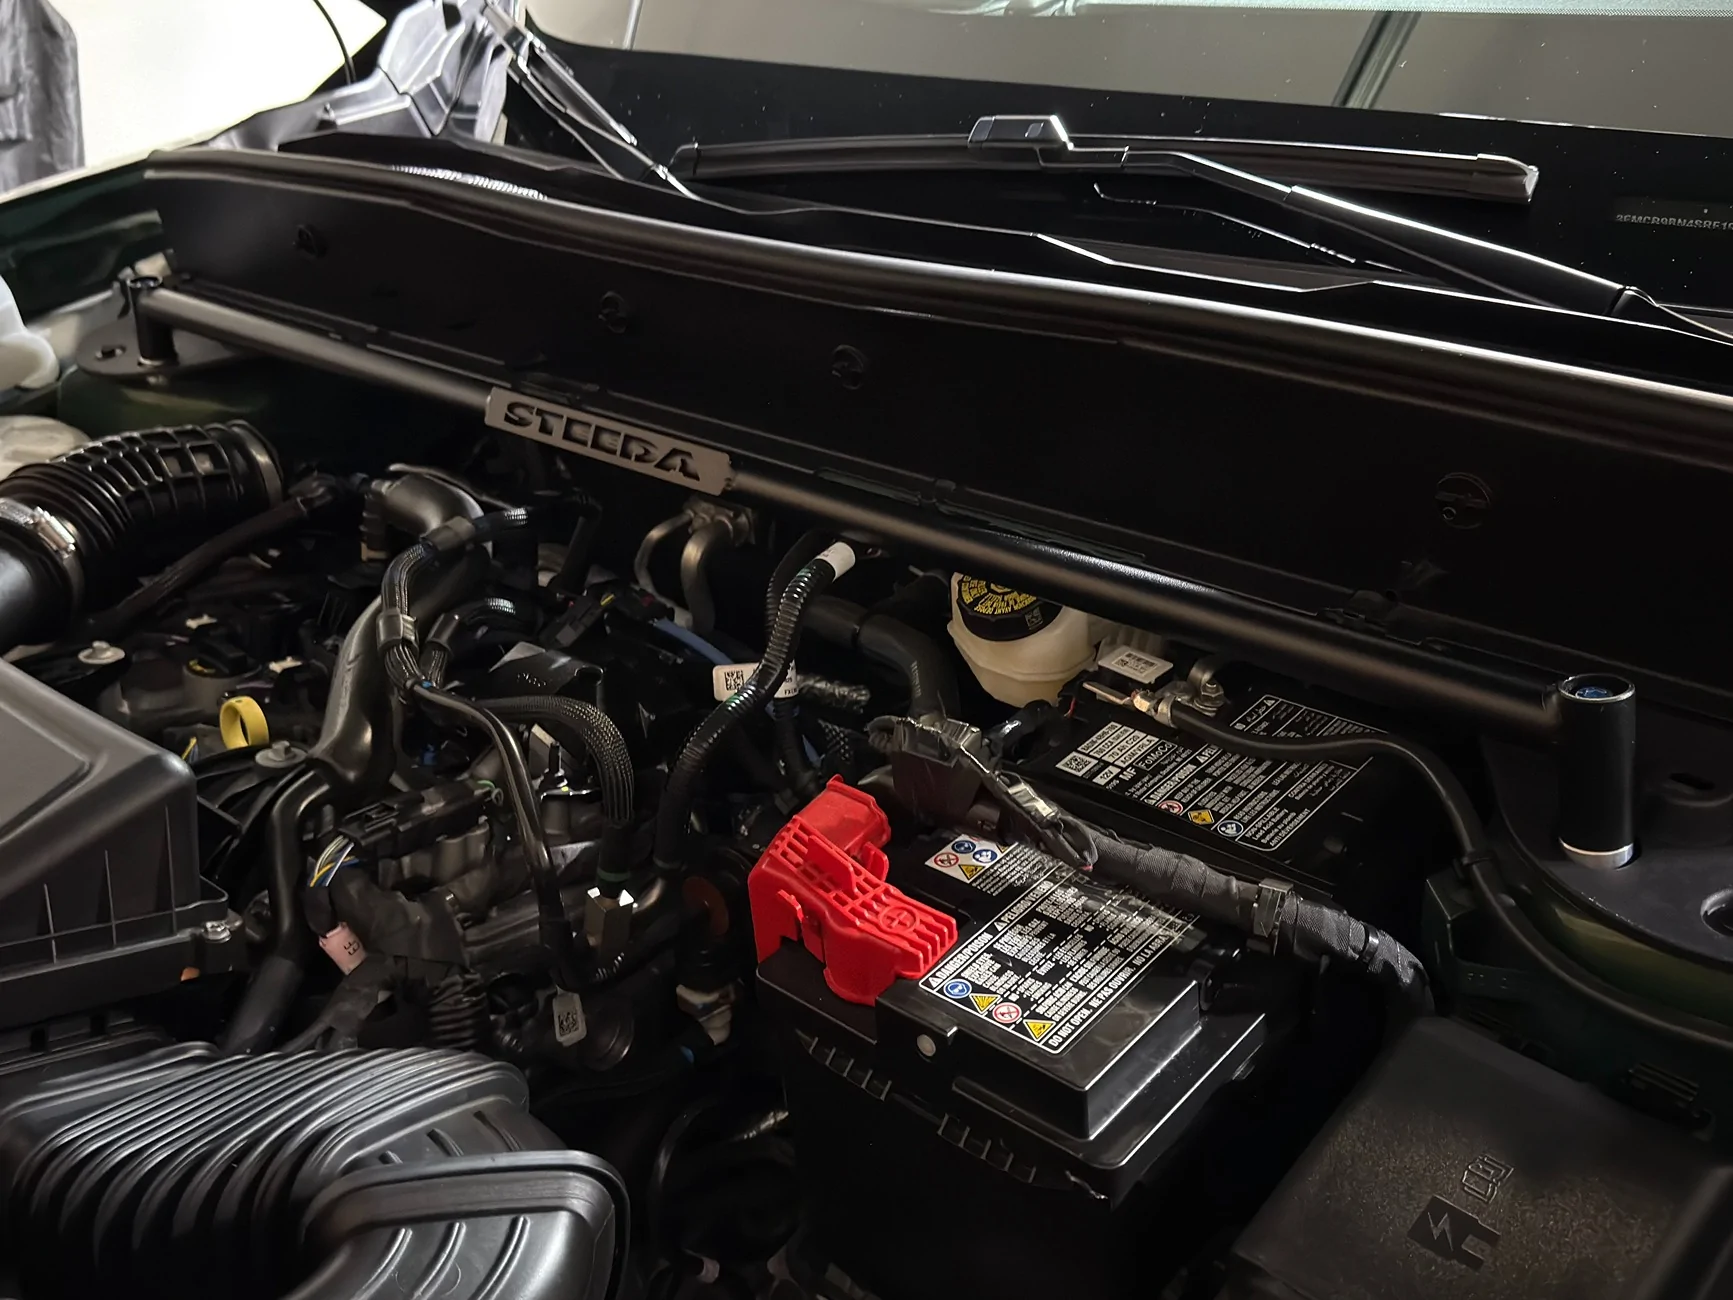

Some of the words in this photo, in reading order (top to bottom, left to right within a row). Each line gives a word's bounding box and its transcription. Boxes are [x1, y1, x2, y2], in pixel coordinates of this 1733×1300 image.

[503, 401, 700, 482] STEEDA
[1098, 769, 1116, 780] 12V
[1107, 751, 1121, 759] 70
[1115, 744, 1130, 752] Ah
[1124, 735, 1141, 745] C20
[1117, 766, 1141, 781] MF
[1136, 741, 1175, 769] FoMoCo
[933, 931, 995, 980] DANGER/POISON
[999, 879, 1055, 923] PELIGRO/VENENO
[1046, 1034, 1064, 1046] DO
[1055, 1022, 1076, 1037] NOT
[1068, 1005, 1094, 1026] OPEN.
[1087, 994, 1105, 1007] NE
[1096, 985, 1115, 998] PAS
[1106, 964, 1137, 989] OUVRIR.
[1130, 954, 1146, 965] NO
[1138, 947, 1154, 957] LA
